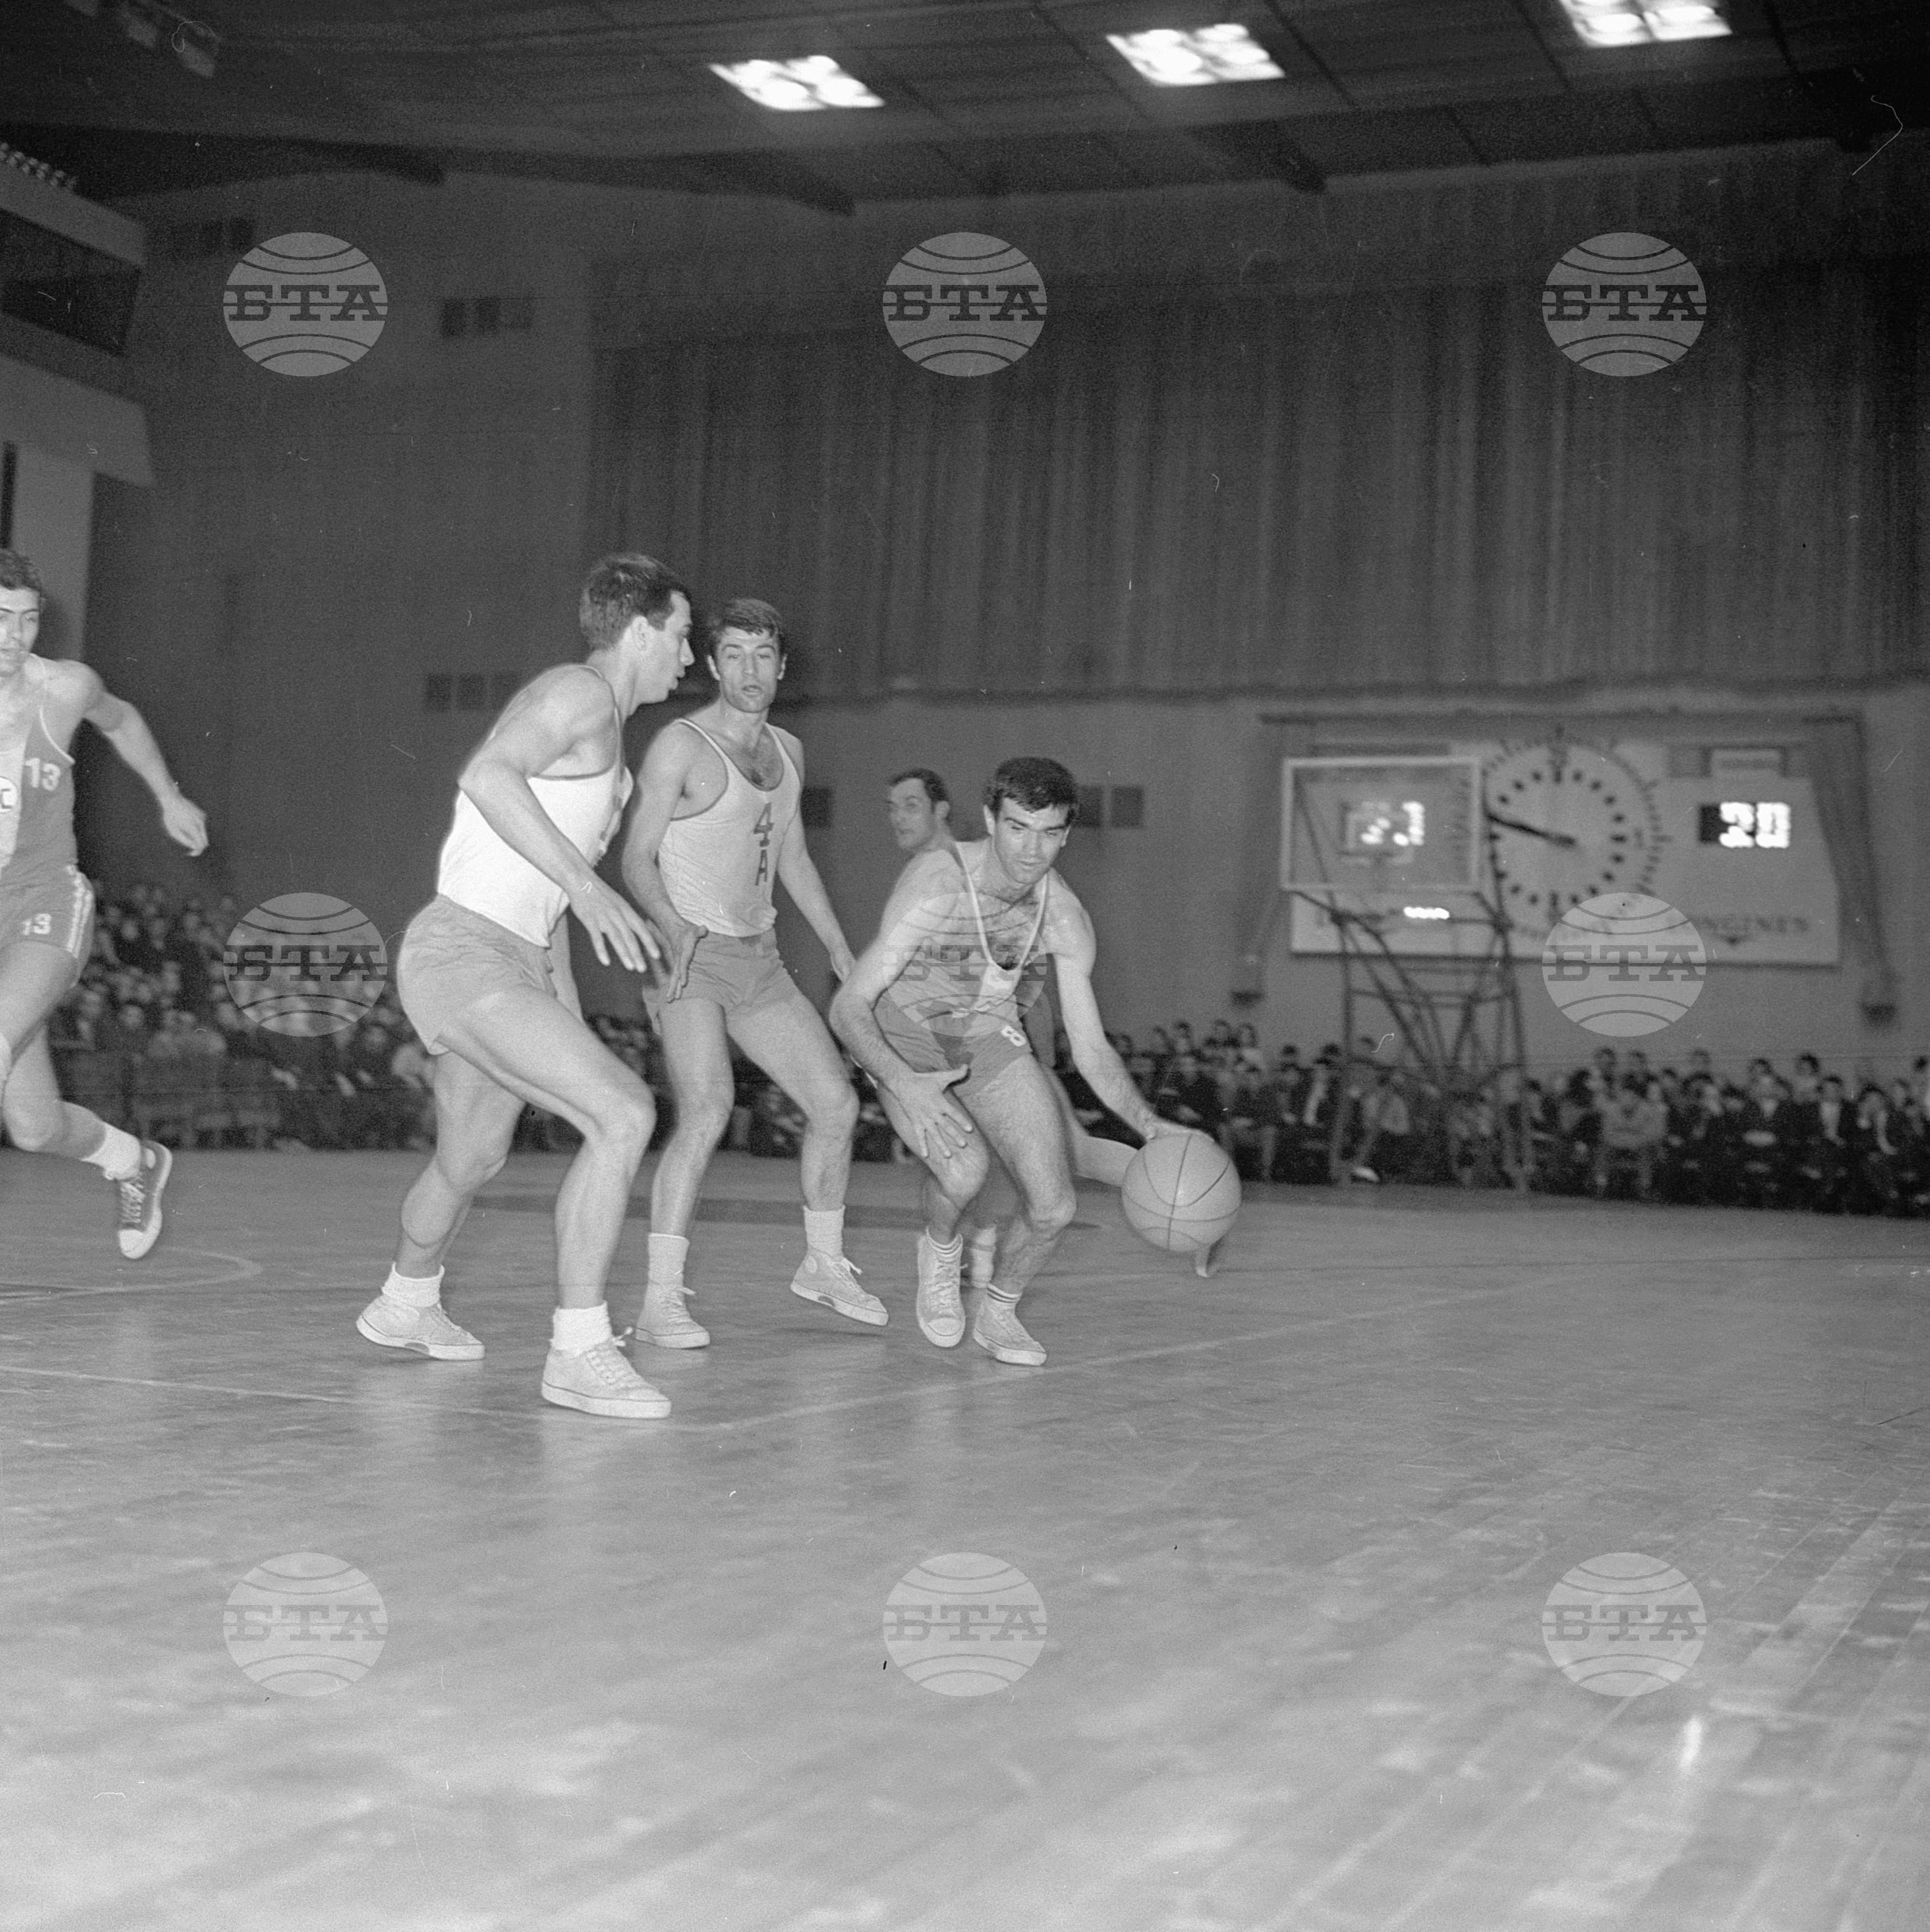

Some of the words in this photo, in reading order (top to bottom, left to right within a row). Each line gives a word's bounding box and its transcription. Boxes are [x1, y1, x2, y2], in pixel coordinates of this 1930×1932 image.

[26, 757, 61, 791] 13
[754, 802, 774, 848] 4
[1719, 801, 1791, 849] 20
[22, 913, 51, 935] 13
[1001, 1025, 1027, 1047] 8
